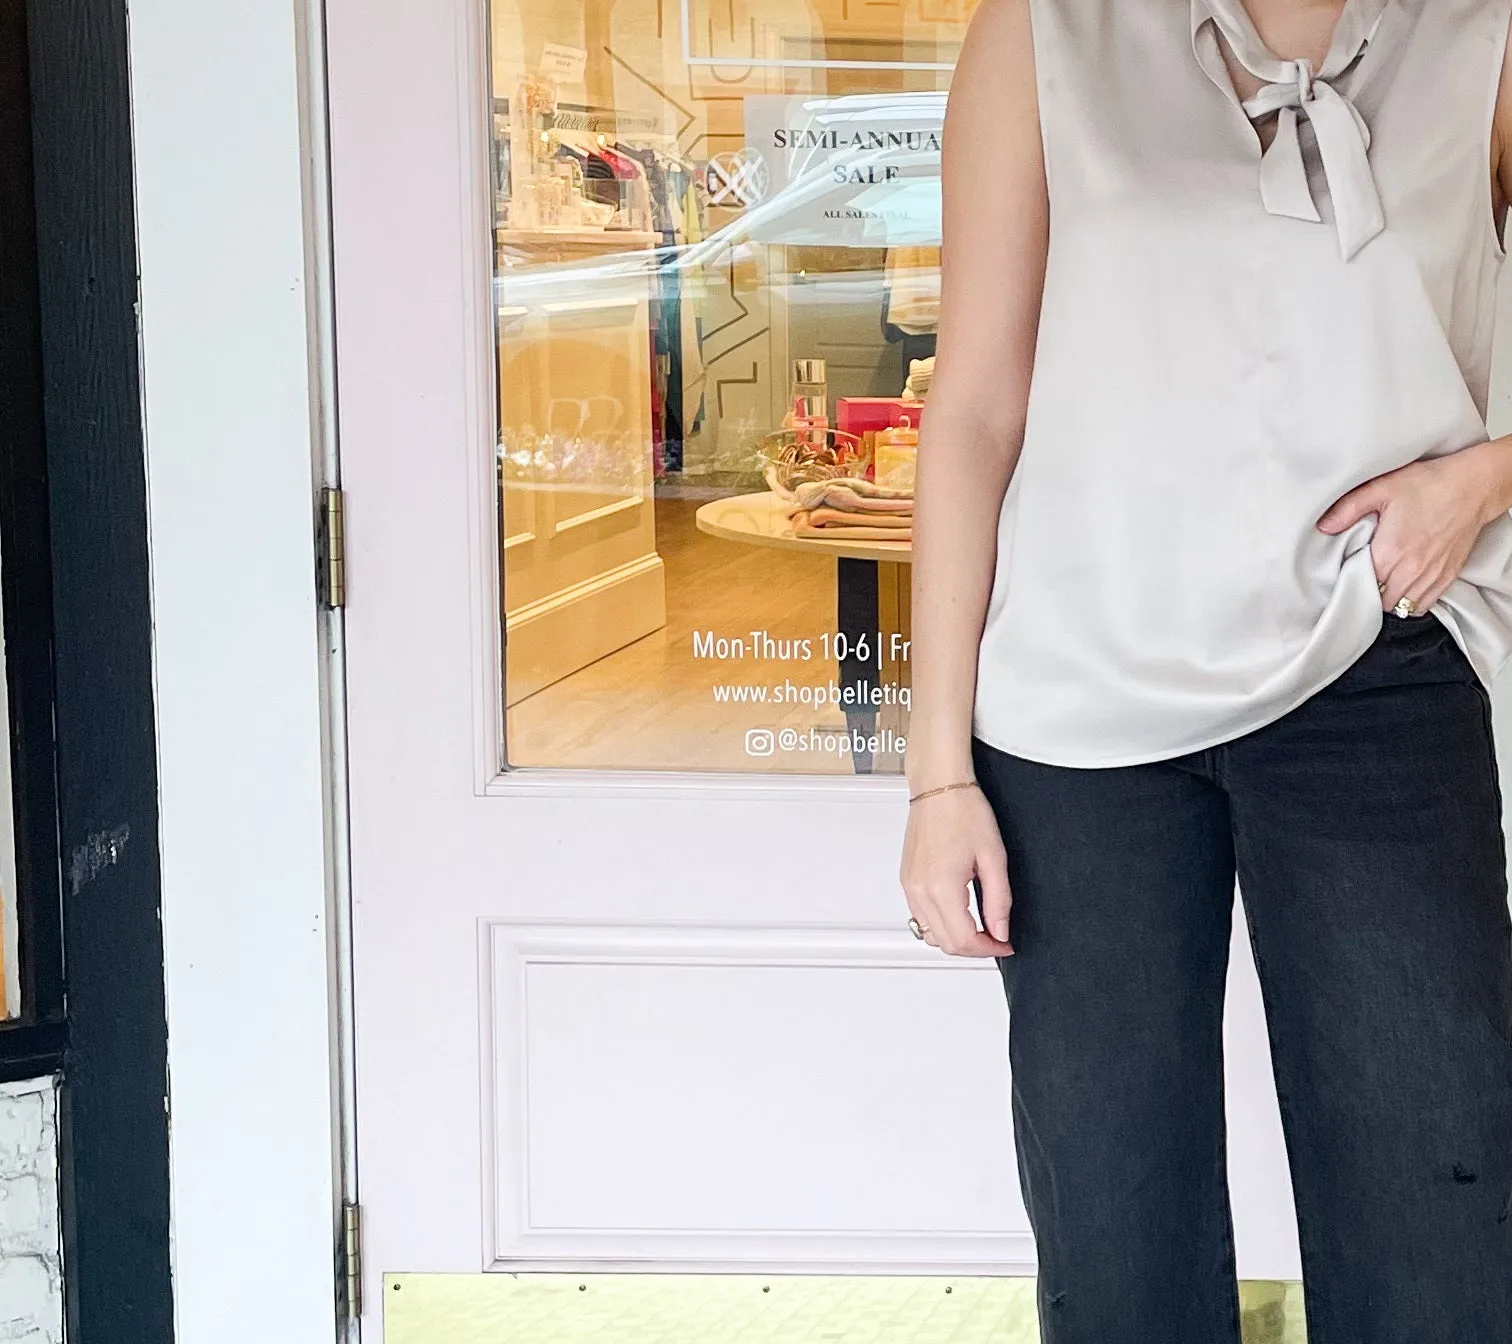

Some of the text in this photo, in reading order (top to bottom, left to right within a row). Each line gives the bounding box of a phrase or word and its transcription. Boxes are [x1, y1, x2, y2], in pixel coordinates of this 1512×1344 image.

[832, 164, 900, 184] SALE
[822, 210, 842, 219] ALL
[845, 210, 878, 220] SALES
[692, 630, 812, 660] Mon-Thurs
[819, 632, 870, 662] 10-6
